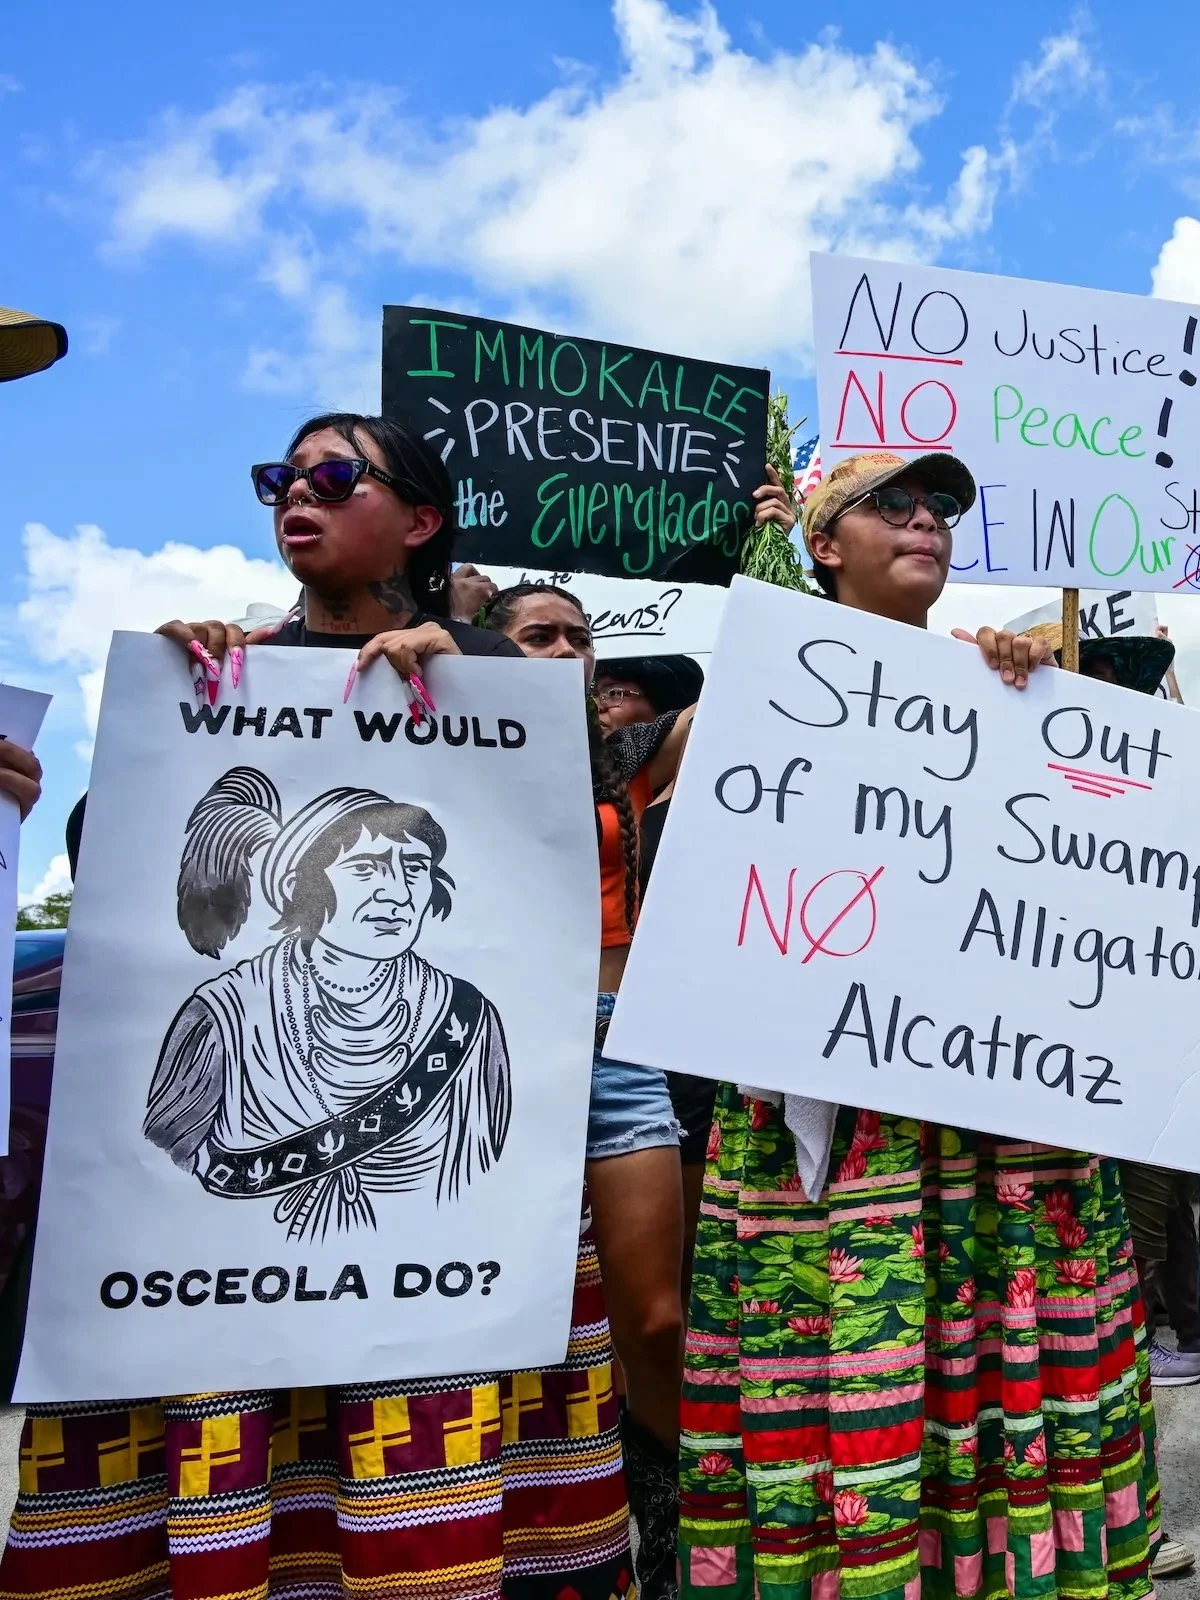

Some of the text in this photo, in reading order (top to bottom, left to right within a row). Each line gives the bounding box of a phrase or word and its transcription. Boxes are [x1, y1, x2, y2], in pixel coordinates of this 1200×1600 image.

[407, 318, 764, 435] IMMOKALEE
[839, 273, 1198, 387] NO Justice!
[463, 398, 717, 473] PRESENTE
[835, 370, 1174, 469] NO Peace!
[454, 473, 750, 573] the Everglades
[1033, 488, 1075, 571] IN
[1089, 493, 1176, 577] Our
[583, 588, 682, 633] eans?
[180, 701, 527, 750] WHAT WOULD
[768, 639, 1173, 781] Stay Out
[855, 781, 953, 884] my
[822, 981, 1123, 1106] Alcatraz
[100, 1260, 501, 1309] OSCEOLA DO?
